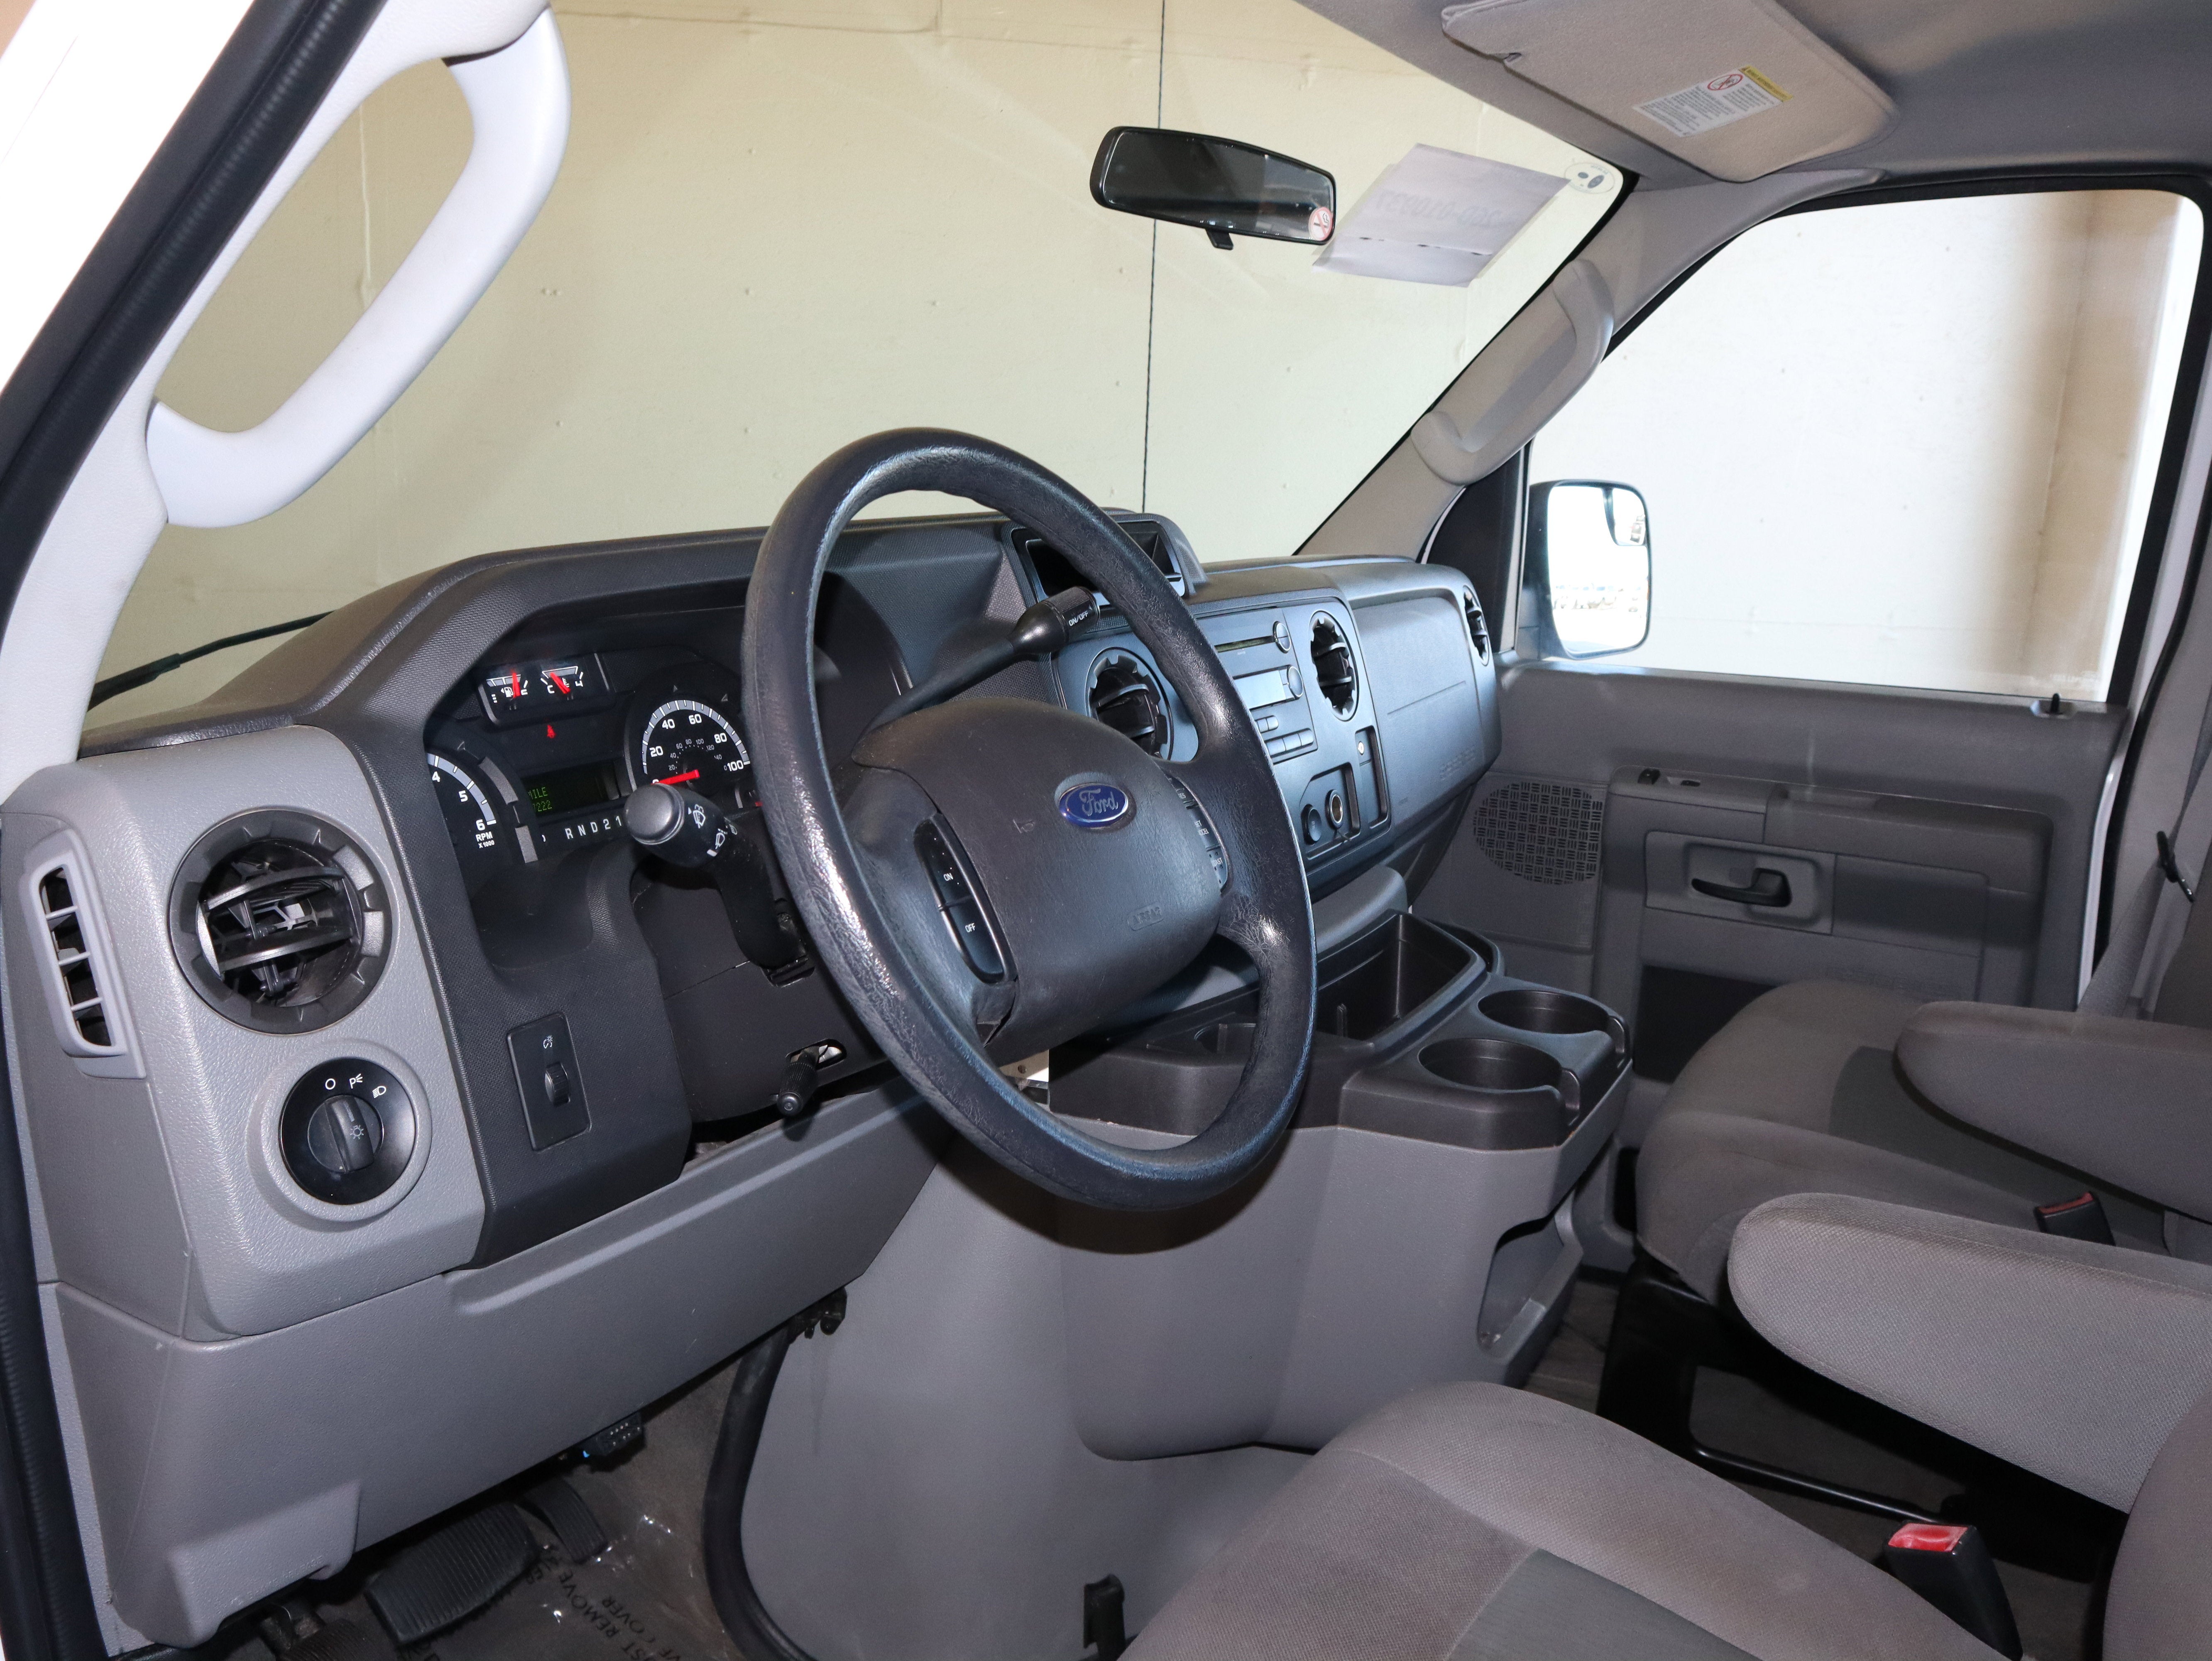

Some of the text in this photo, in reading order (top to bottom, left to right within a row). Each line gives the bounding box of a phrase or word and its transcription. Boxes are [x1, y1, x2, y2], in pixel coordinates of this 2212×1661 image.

[1068, 610, 1089, 627] ON/OFF
[547, 685, 555, 694] C
[662, 719, 675, 729] 40
[688, 714, 702, 725] 60
[714, 733, 727, 744] 80
[649, 746, 663, 757] 20
[727, 760, 744, 772] 100
[432, 771, 440, 782] 4
[458, 790, 468, 802] 5
[1079, 788, 1119, 817] Ford
[476, 819, 486, 831] 6
[565, 816, 622, 840] R N D 2 1
[475, 831, 493, 842] RPM
[943, 872, 954, 882] ON
[965, 923, 976, 933] OFF
[558, 1568, 620, 1638] REMOVE
